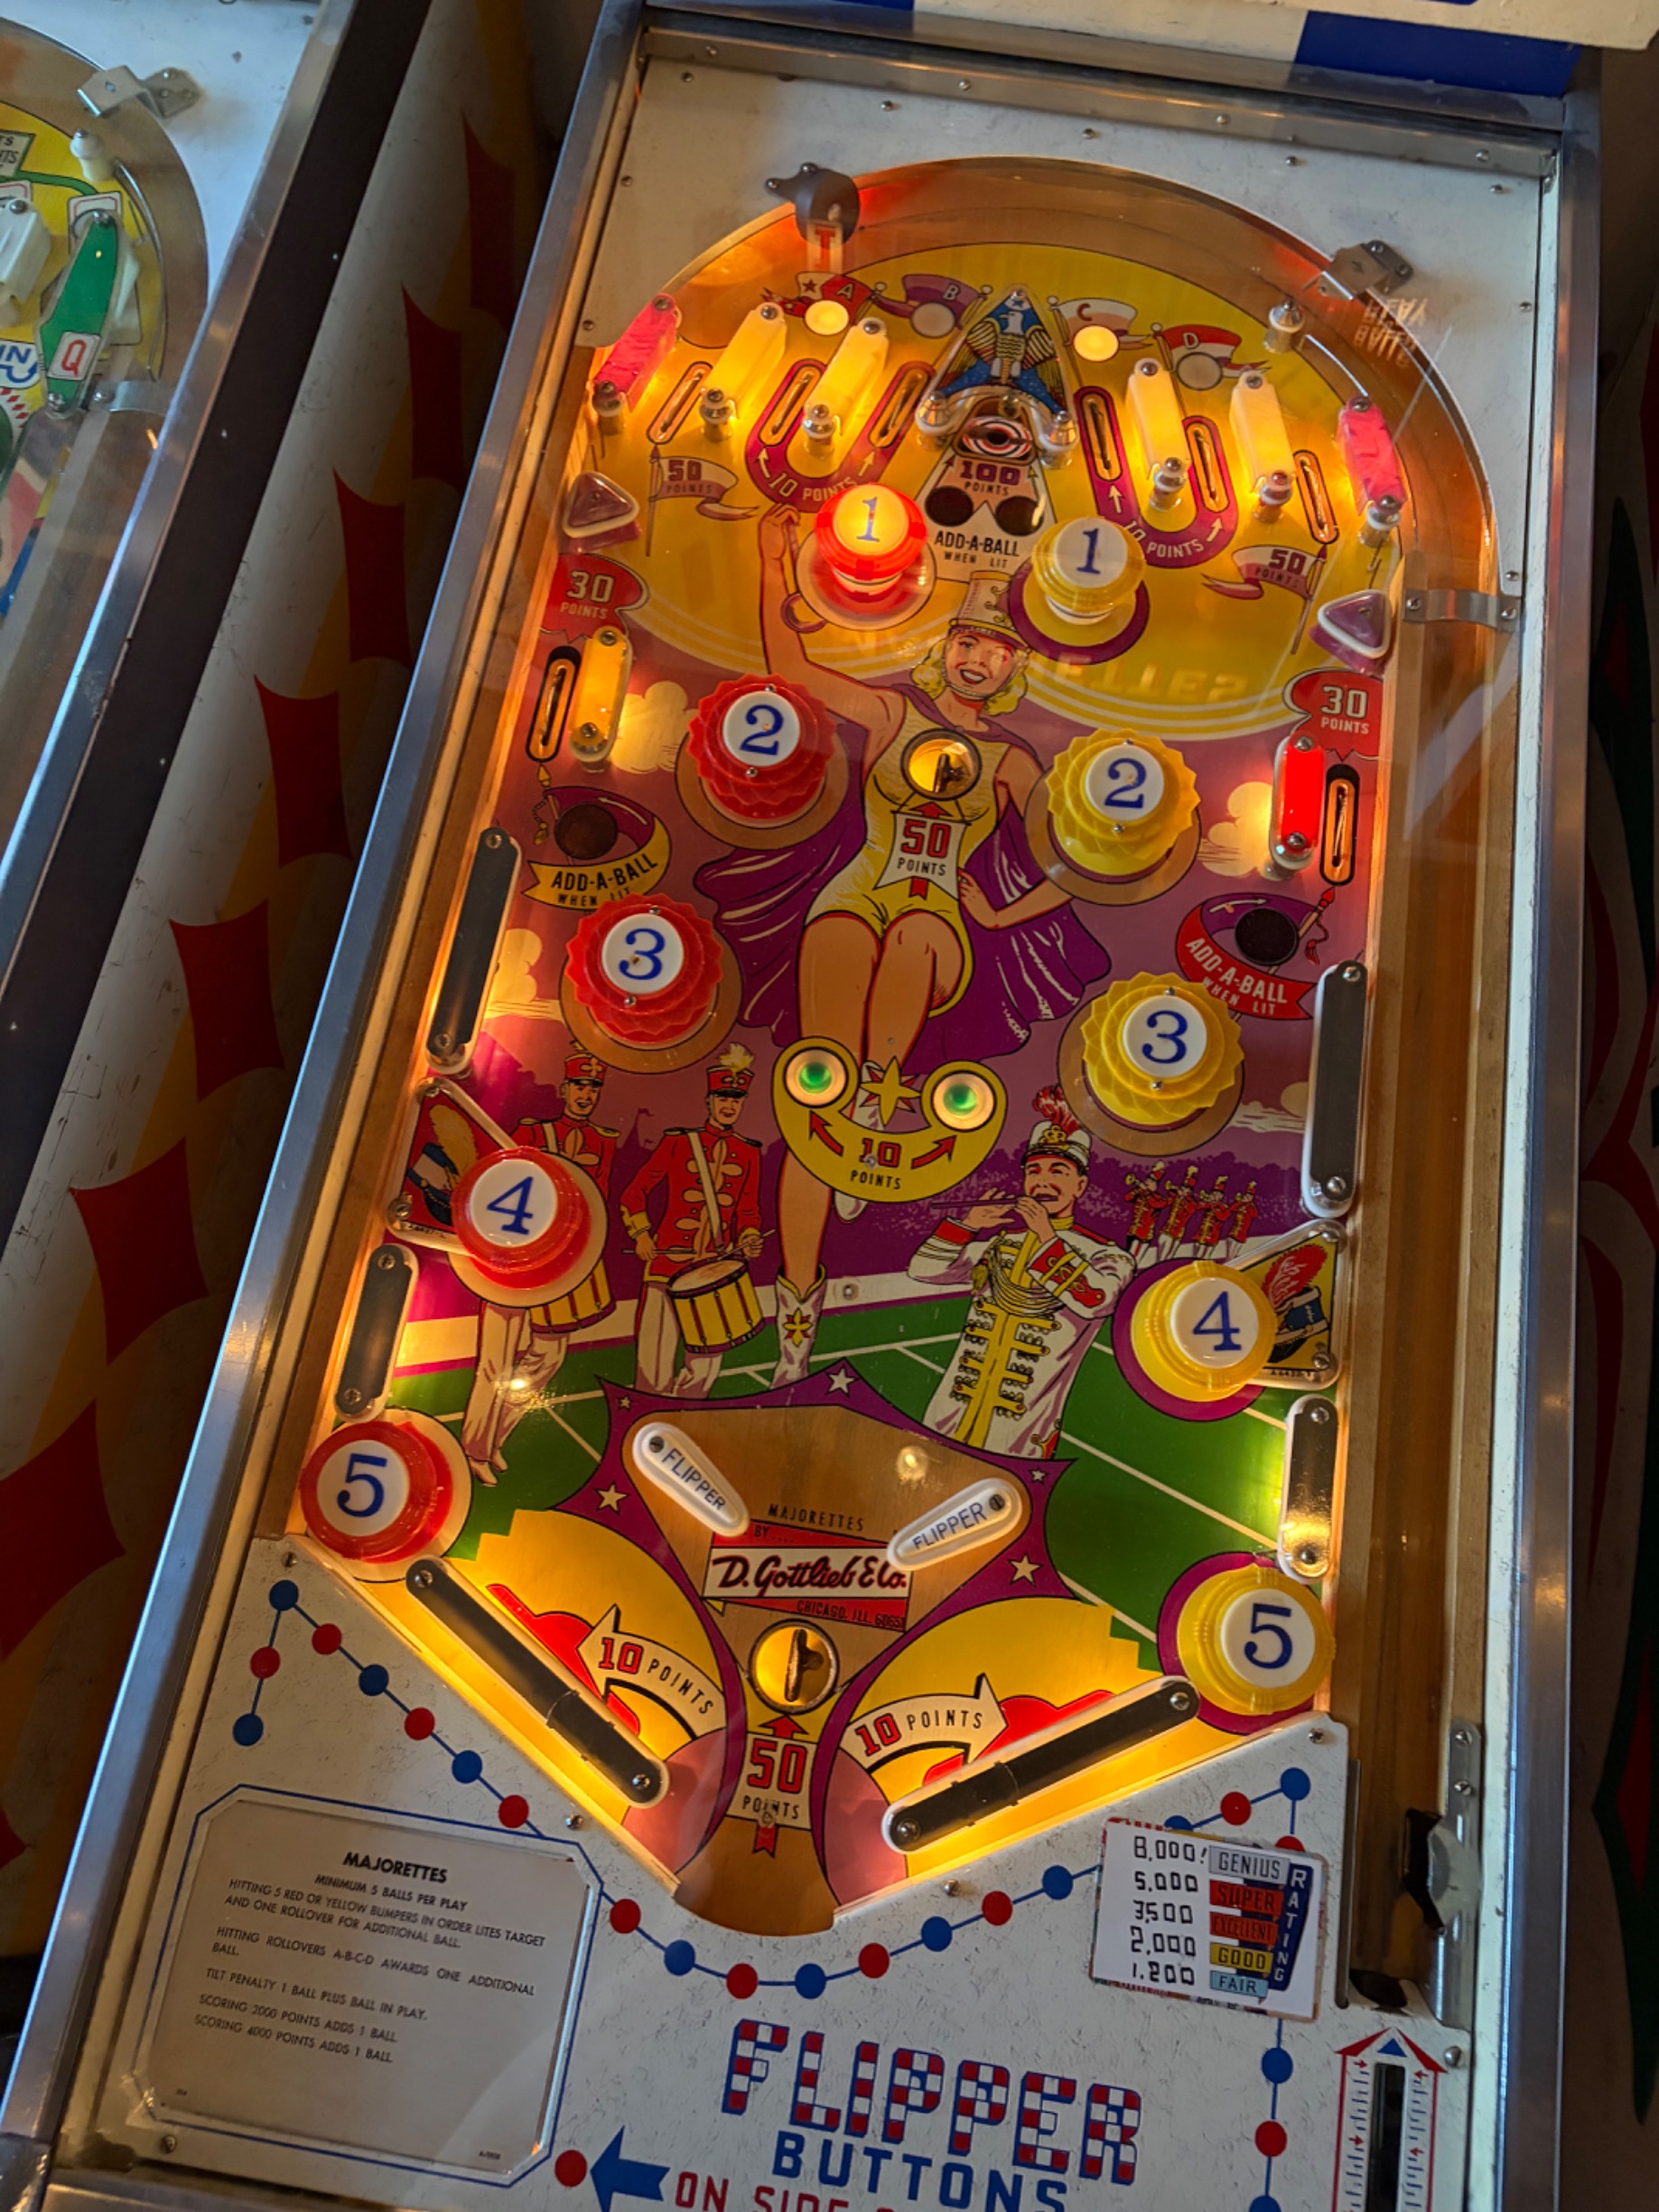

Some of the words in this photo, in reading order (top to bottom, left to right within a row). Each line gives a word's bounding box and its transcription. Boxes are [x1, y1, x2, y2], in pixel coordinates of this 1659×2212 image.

[836, 283, 855, 301] A
[943, 285, 959, 301] B
[1076, 303, 1092, 322] C
[61, 340, 87, 377] Q
[1183, 331, 1200, 350] D
[666, 481, 713, 495] POINTS
[667, 460, 702, 482] 50
[769, 472, 798, 498] 10
[959, 459, 1021, 486] 100
[965, 483, 1010, 497] POINTS
[856, 497, 881, 543] 1
[934, 529, 1021, 557] ADD-A-BALL
[944, 551, 977, 565] WHEN
[990, 556, 1008, 569] LIT
[1076, 527, 1102, 575] 1
[1146, 538, 1205, 558] POINTS
[1269, 548, 1307, 572] 50
[565, 570, 616, 604] 30
[560, 602, 608, 620] POINTS
[1319, 685, 1369, 718] 30
[739, 704, 785, 757] 2
[1321, 716, 1370, 735] POINTS
[1103, 757, 1147, 809] 2
[900, 820, 951, 857] 50
[551, 853, 659, 892] ADD-A-BALL
[896, 856, 946, 877] POINTS
[558, 893, 598, 906] WHEN
[619, 928, 666, 981] 3
[1185, 937, 1288, 1004] ADD-A-BALL
[1202, 976, 1240, 1007] WHEN
[1253, 1001, 1276, 1016] LIT
[1141, 1010, 1188, 1065] 3
[860, 1137, 902, 1169] 10
[850, 1169, 902, 1191] POINTS
[486, 1176, 535, 1236] 4
[1192, 1291, 1242, 1353] 4
[337, 1452, 388, 1518] 5
[660, 1447, 726, 1512] FLIPPER
[768, 1503, 864, 1532] MAJORETTES
[911, 1501, 988, 1551] FLIPPER
[713, 1554, 750, 1589] D.
[753, 1554, 862, 1598] Gottlieb
[1244, 1602, 1293, 1669] 5
[598, 1638, 644, 1675] 10
[647, 1658, 714, 1714] POINTS
[854, 1713, 902, 1757] 10
[906, 1709, 983, 1731] POINTS
[747, 1738, 808, 1794] 50
[741, 1795, 800, 1819] POINTS
[342, 1852, 448, 1883] MAJORETTES
[1219, 1852, 1281, 1880] GENIUS
[314, 1874, 367, 1893] MINIMUM
[370, 1885, 377, 1895] 5
[382, 1886, 413, 1901] BALLS
[416, 1893, 435, 1906] PER
[439, 1898, 468, 1911] PLAY
[1217, 1884, 1275, 1913] SUPER
[225, 1895, 250, 1908] AND
[254, 1899, 277, 1913] ONE
[280, 1905, 334, 1924] ROLLOVER
[337, 1916, 359, 1929] FOR
[363, 1921, 428, 1943] ADDITIONAL
[228, 1879, 273, 1896] HITTING
[274, 1887, 282, 1897] 5
[283, 1889, 304, 1901] RED
[306, 1893, 323, 1904] OR
[326, 1897, 368, 1913] YELLOW
[369, 1905, 418, 1923] BUMPERS
[421, 1915, 435, 1926] IN
[437, 1918, 473, 1934] ORDER
[475, 1925, 501, 1939] LITES
[505, 1930, 545, 1946] TARGET
[1211, 1915, 1273, 1942] EXCELLENT
[211, 1942, 240, 1956] BALL.
[217, 1926, 260, 1943] HITTING
[266, 1936, 326, 1956] ROLLOVERS
[332, 1949, 375, 1965] A-B-C-D
[380, 1958, 429, 1976] AWARDS
[436, 1968, 461, 1982] ONE
[468, 1974, 535, 1996] ADDITIONAL
[1218, 1946, 1267, 1970] GOOD
[207, 1967, 227, 1981] TILT
[229, 1973, 276, 1991] PENALTY
[291, 1985, 317, 1999] BALL
[320, 1991, 346, 2005] PLUS
[350, 1996, 376, 2011] BALL
[379, 2002, 394, 2014] IN
[1219, 1976, 1257, 1994] FAIR
[199, 1993, 247, 2012] SCORING
[252, 2004, 277, 2020] 2000
[281, 2010, 321, 2028] POINTS
[323, 2020, 355, 2035] ADDS
[195, 2013, 243, 2033] SCORING
[247, 2025, 272, 2040] 4000
[275, 2031, 315, 2049] POINTS
[319, 2040, 350, 2055] ADDS
[722, 2018, 1142, 2186] FLIPPER
[772, 2130, 1068, 2212] BUTTONS
[675, 2170, 729, 2212] ON
